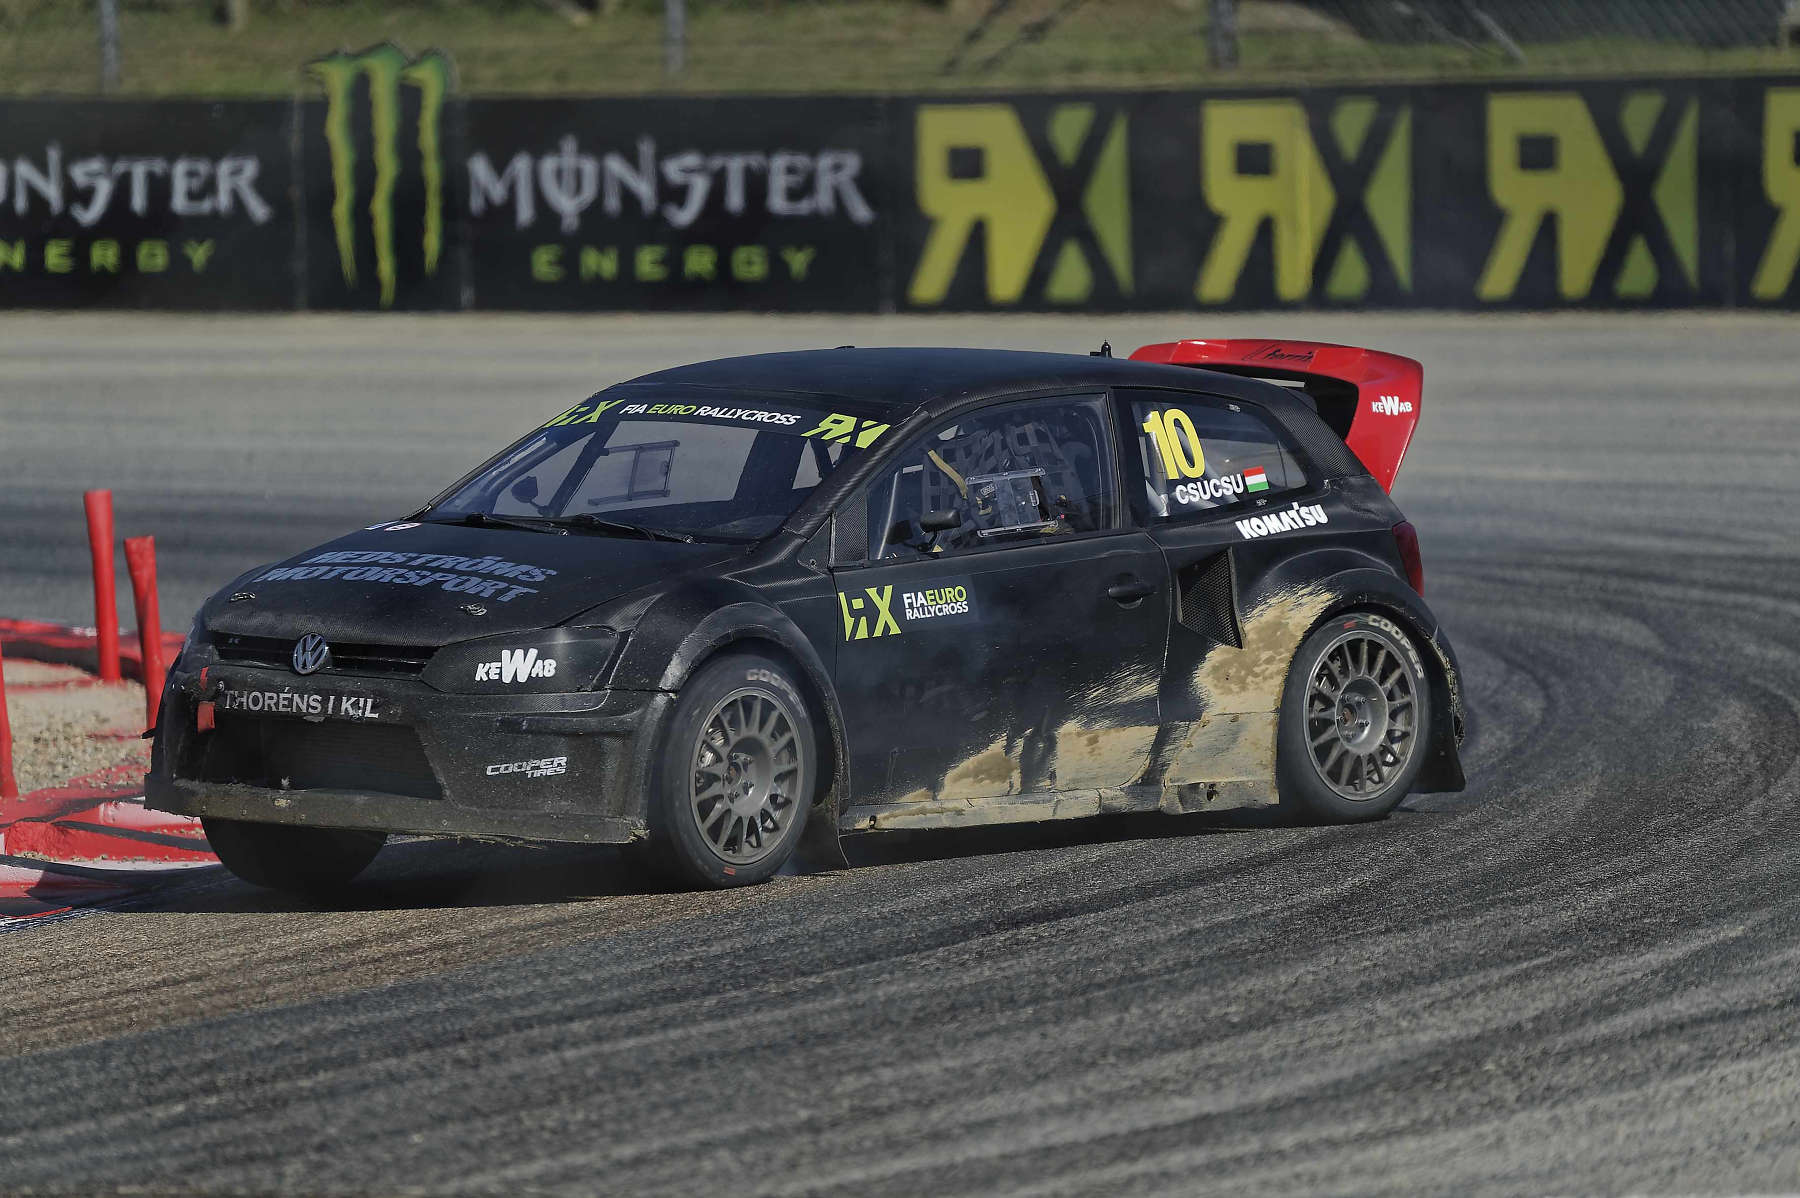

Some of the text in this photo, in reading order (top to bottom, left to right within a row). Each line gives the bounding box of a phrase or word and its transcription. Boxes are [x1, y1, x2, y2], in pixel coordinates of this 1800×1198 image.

[0, 141, 273, 228] NSTER
[466, 134, 874, 234] MONSTER
[531, 243, 816, 282] ENERGY
[619, 404, 802, 426] FIA EURO RALLYCROSS
[1143, 408, 1206, 480] 10
[1175, 473, 1245, 505] CSUCSU
[1235, 502, 1329, 540] KOMATSU
[252, 566, 540, 602] MOTORSPORT
[905, 601, 969, 621] RALLYCROSS
[475, 648, 556, 684] KEWAB
[224, 686, 322, 715] THORÉNS
[486, 756, 567, 776] COOPER
[526, 767, 566, 779] TIRES
